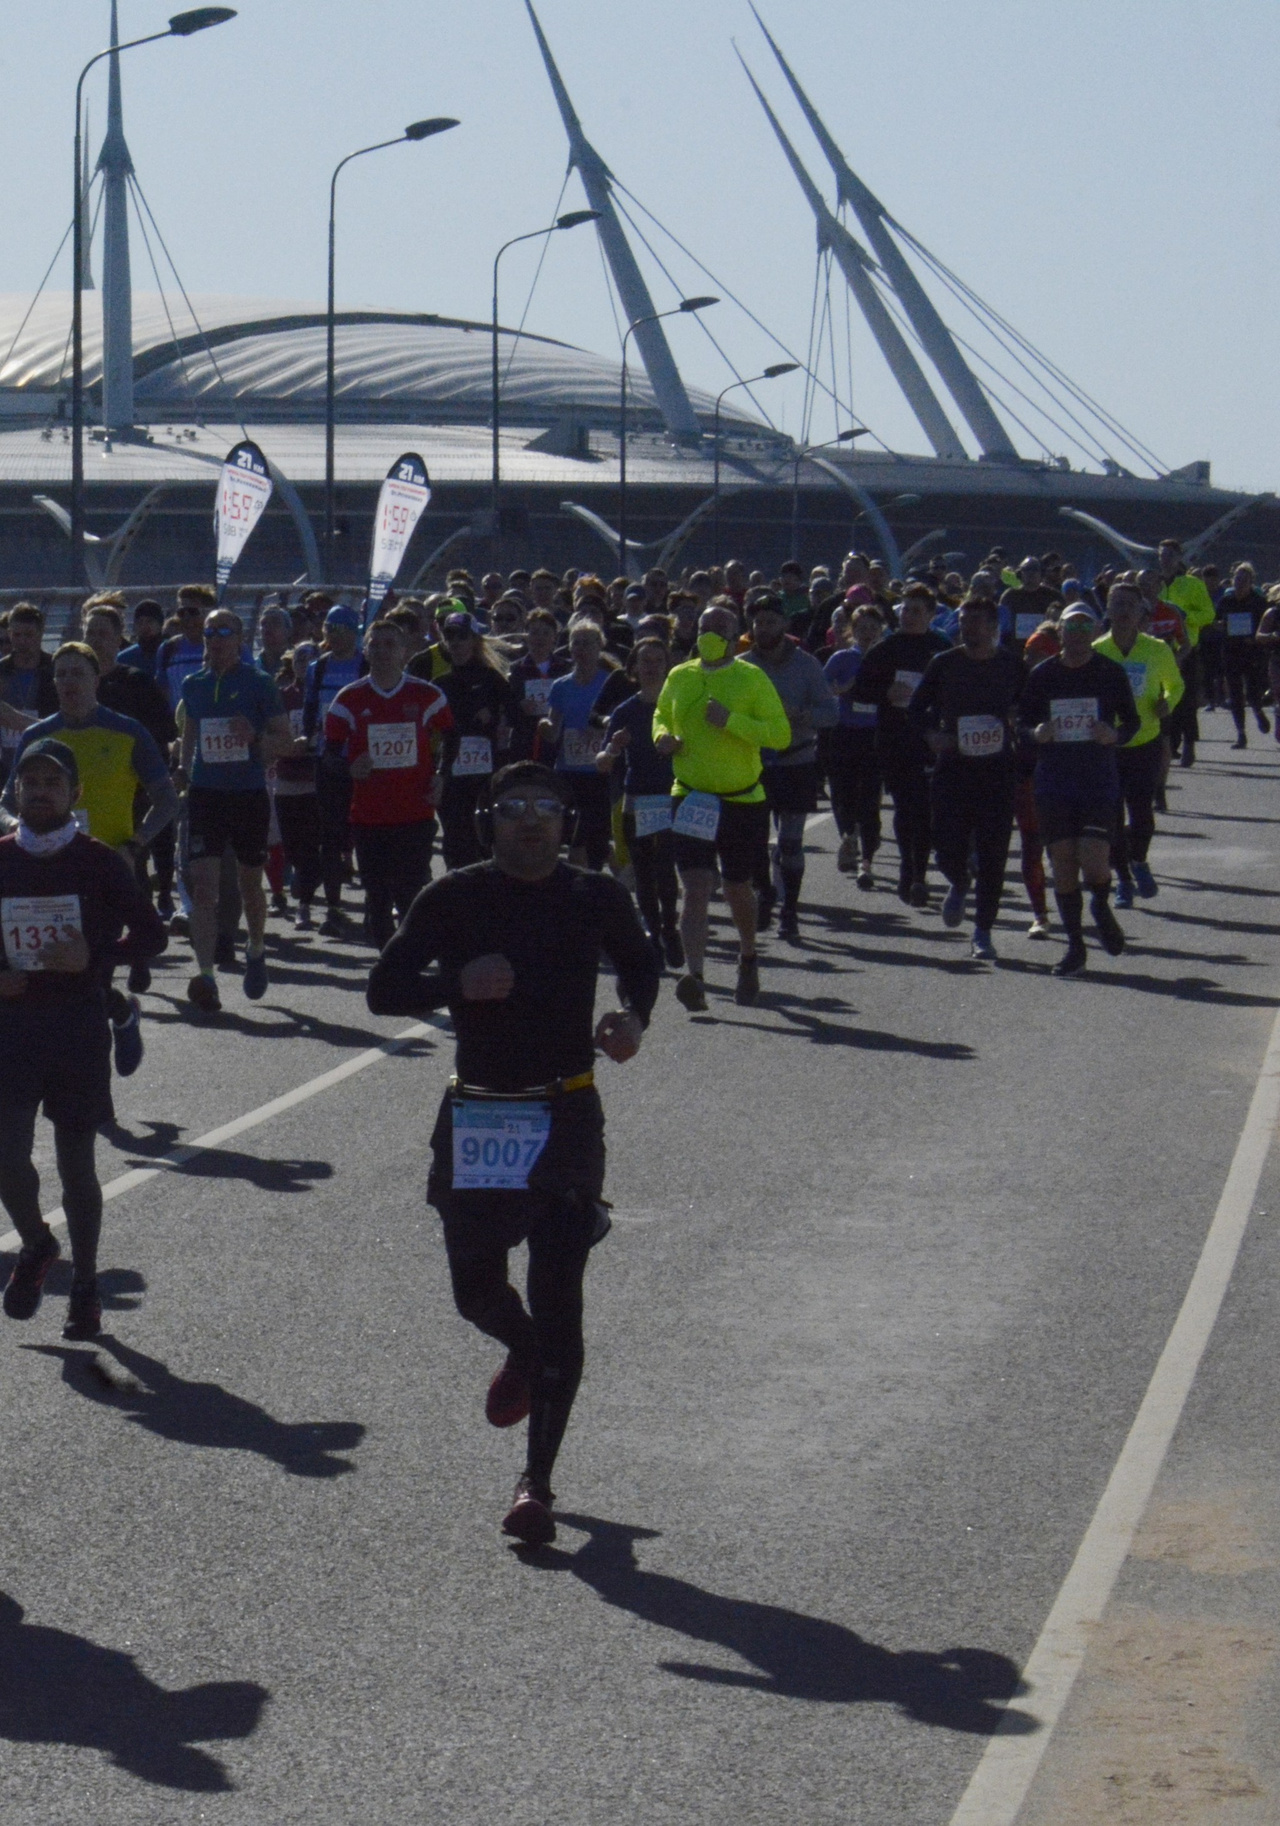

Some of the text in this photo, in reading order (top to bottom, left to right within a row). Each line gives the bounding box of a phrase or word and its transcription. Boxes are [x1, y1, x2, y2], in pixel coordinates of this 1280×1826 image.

[237, 450, 253, 469] 21
[398, 463, 413, 481] 21
[961, 728, 1002, 746] 1095
[371, 738, 415, 756] 1207
[507, 1123, 520, 1134] 21
[461, 1137, 541, 1167] 9007
